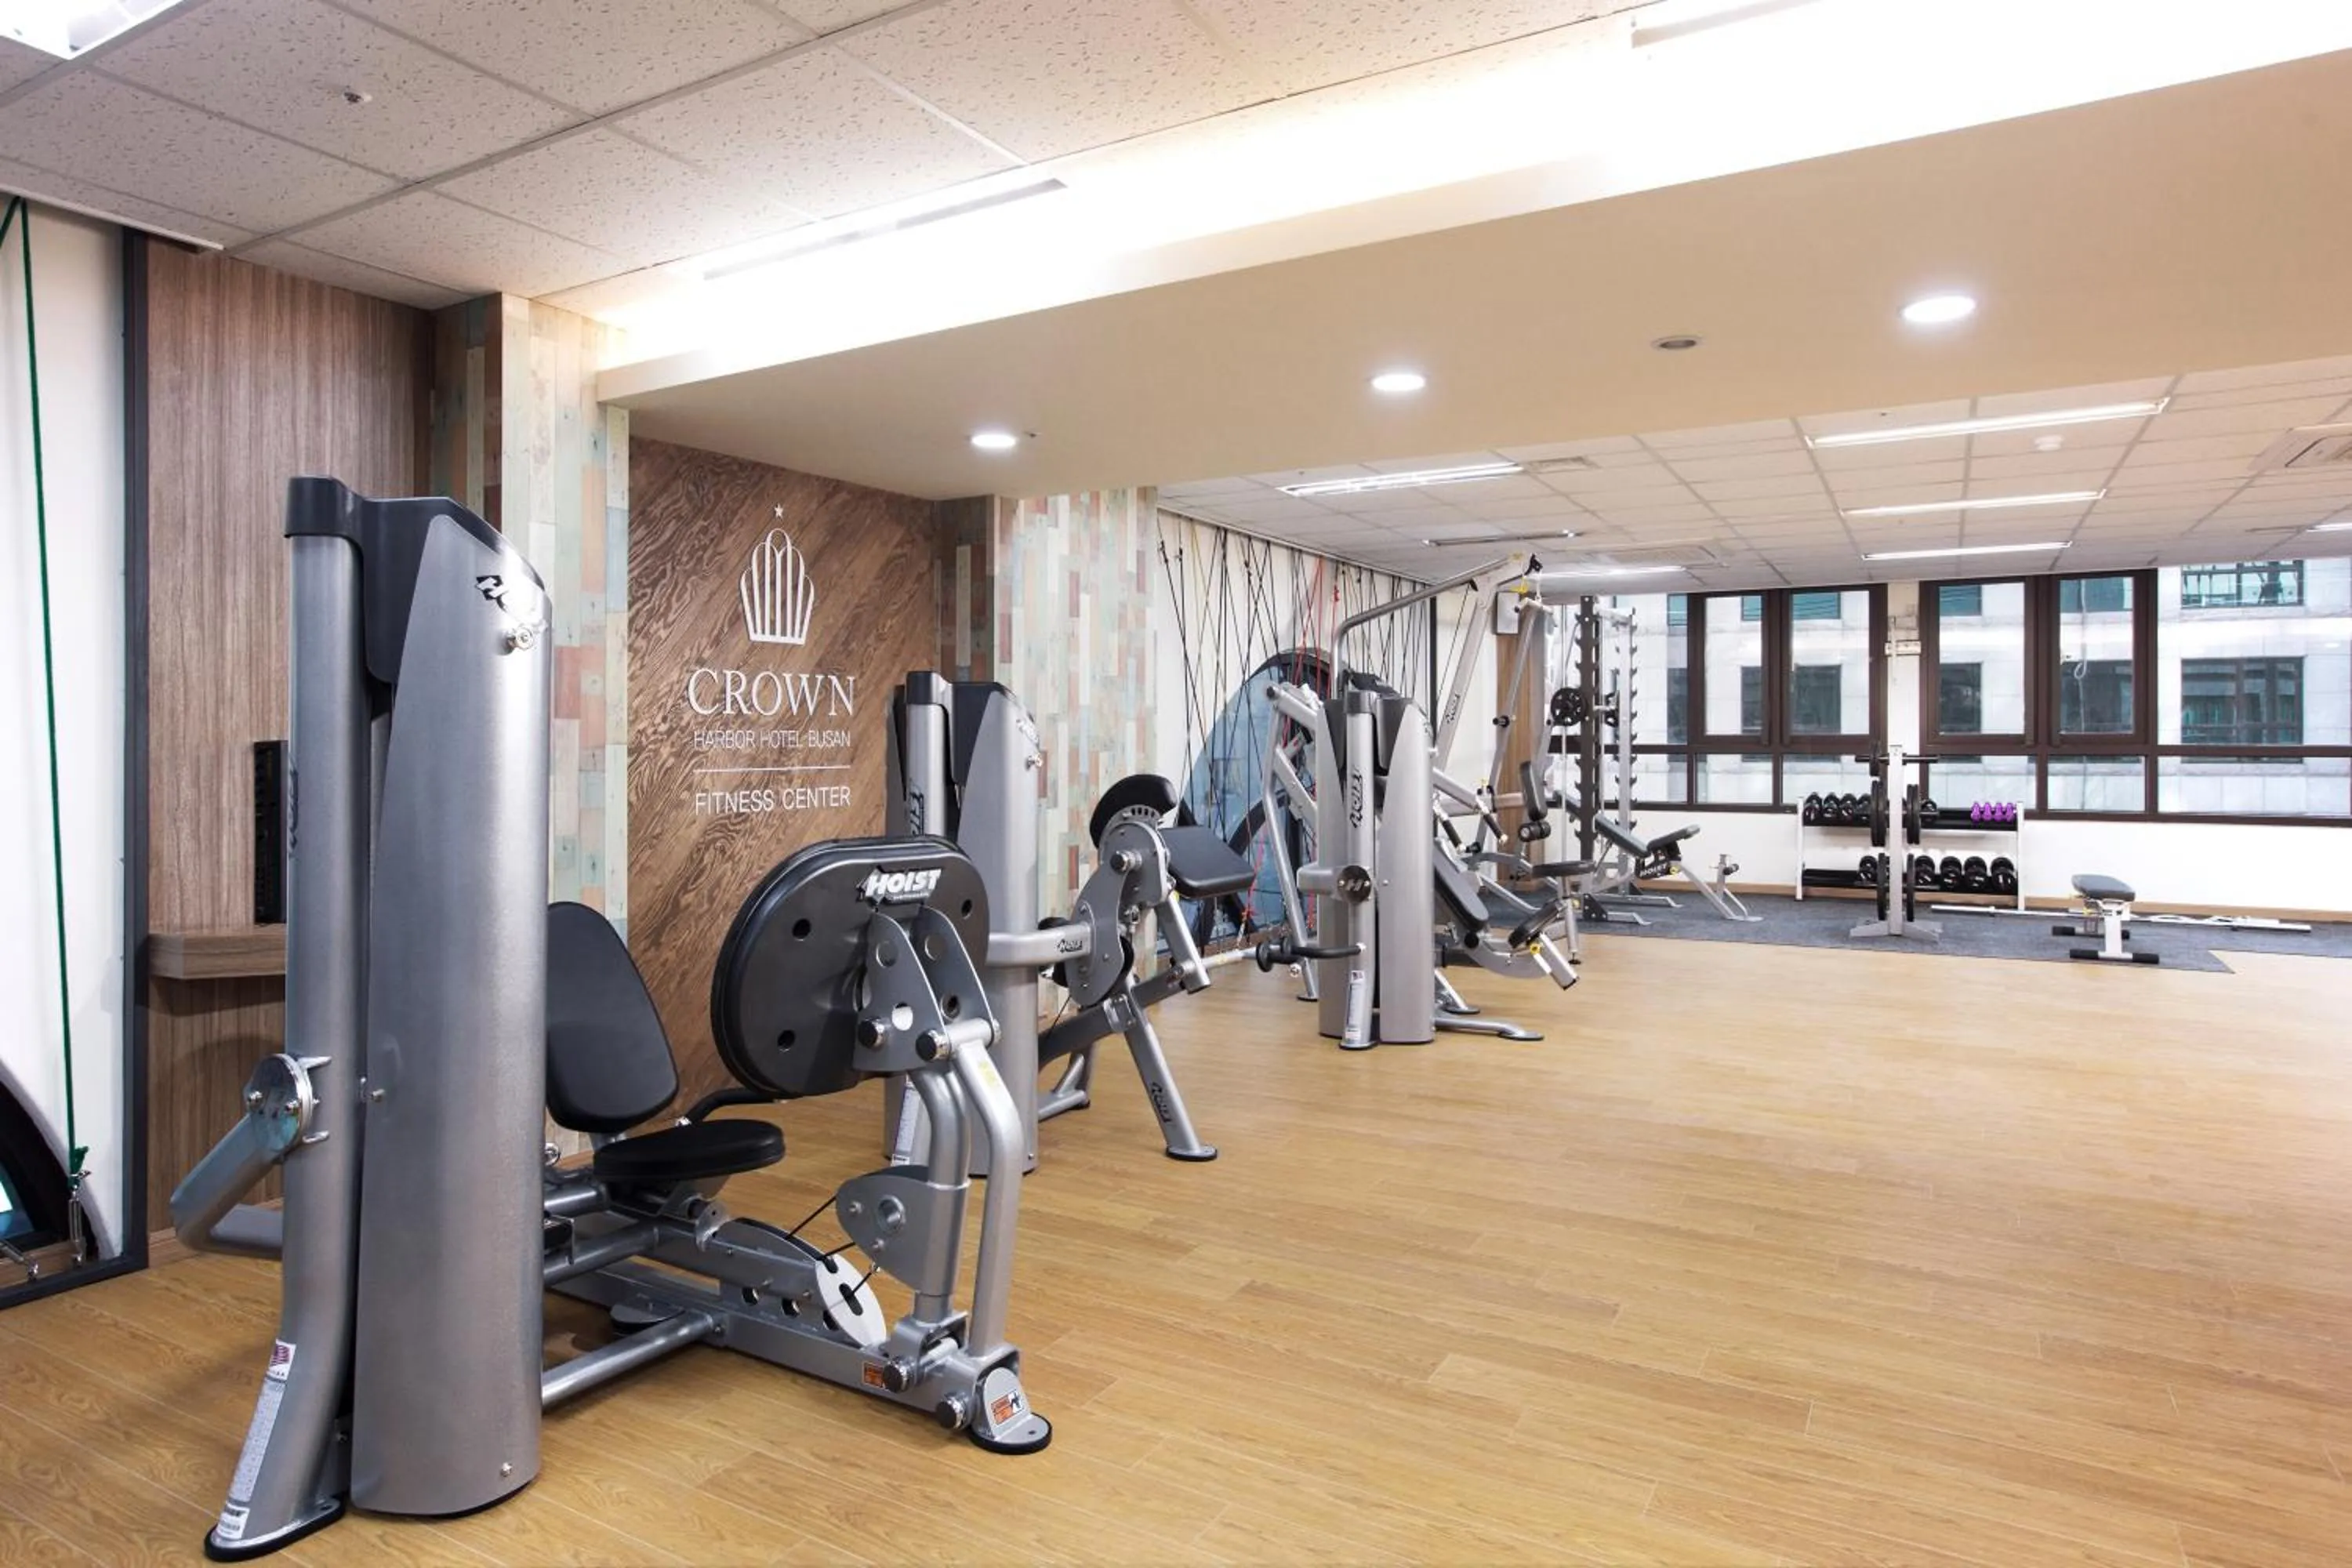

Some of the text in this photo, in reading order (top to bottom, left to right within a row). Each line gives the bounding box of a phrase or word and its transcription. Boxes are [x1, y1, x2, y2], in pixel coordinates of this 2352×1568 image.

[688, 667, 855, 717] CROWN
[694, 730, 851, 749] HARBOR HOTEL BUSAN
[695, 786, 851, 815] FITNESS CENTER
[865, 869, 942, 897] HOIST
